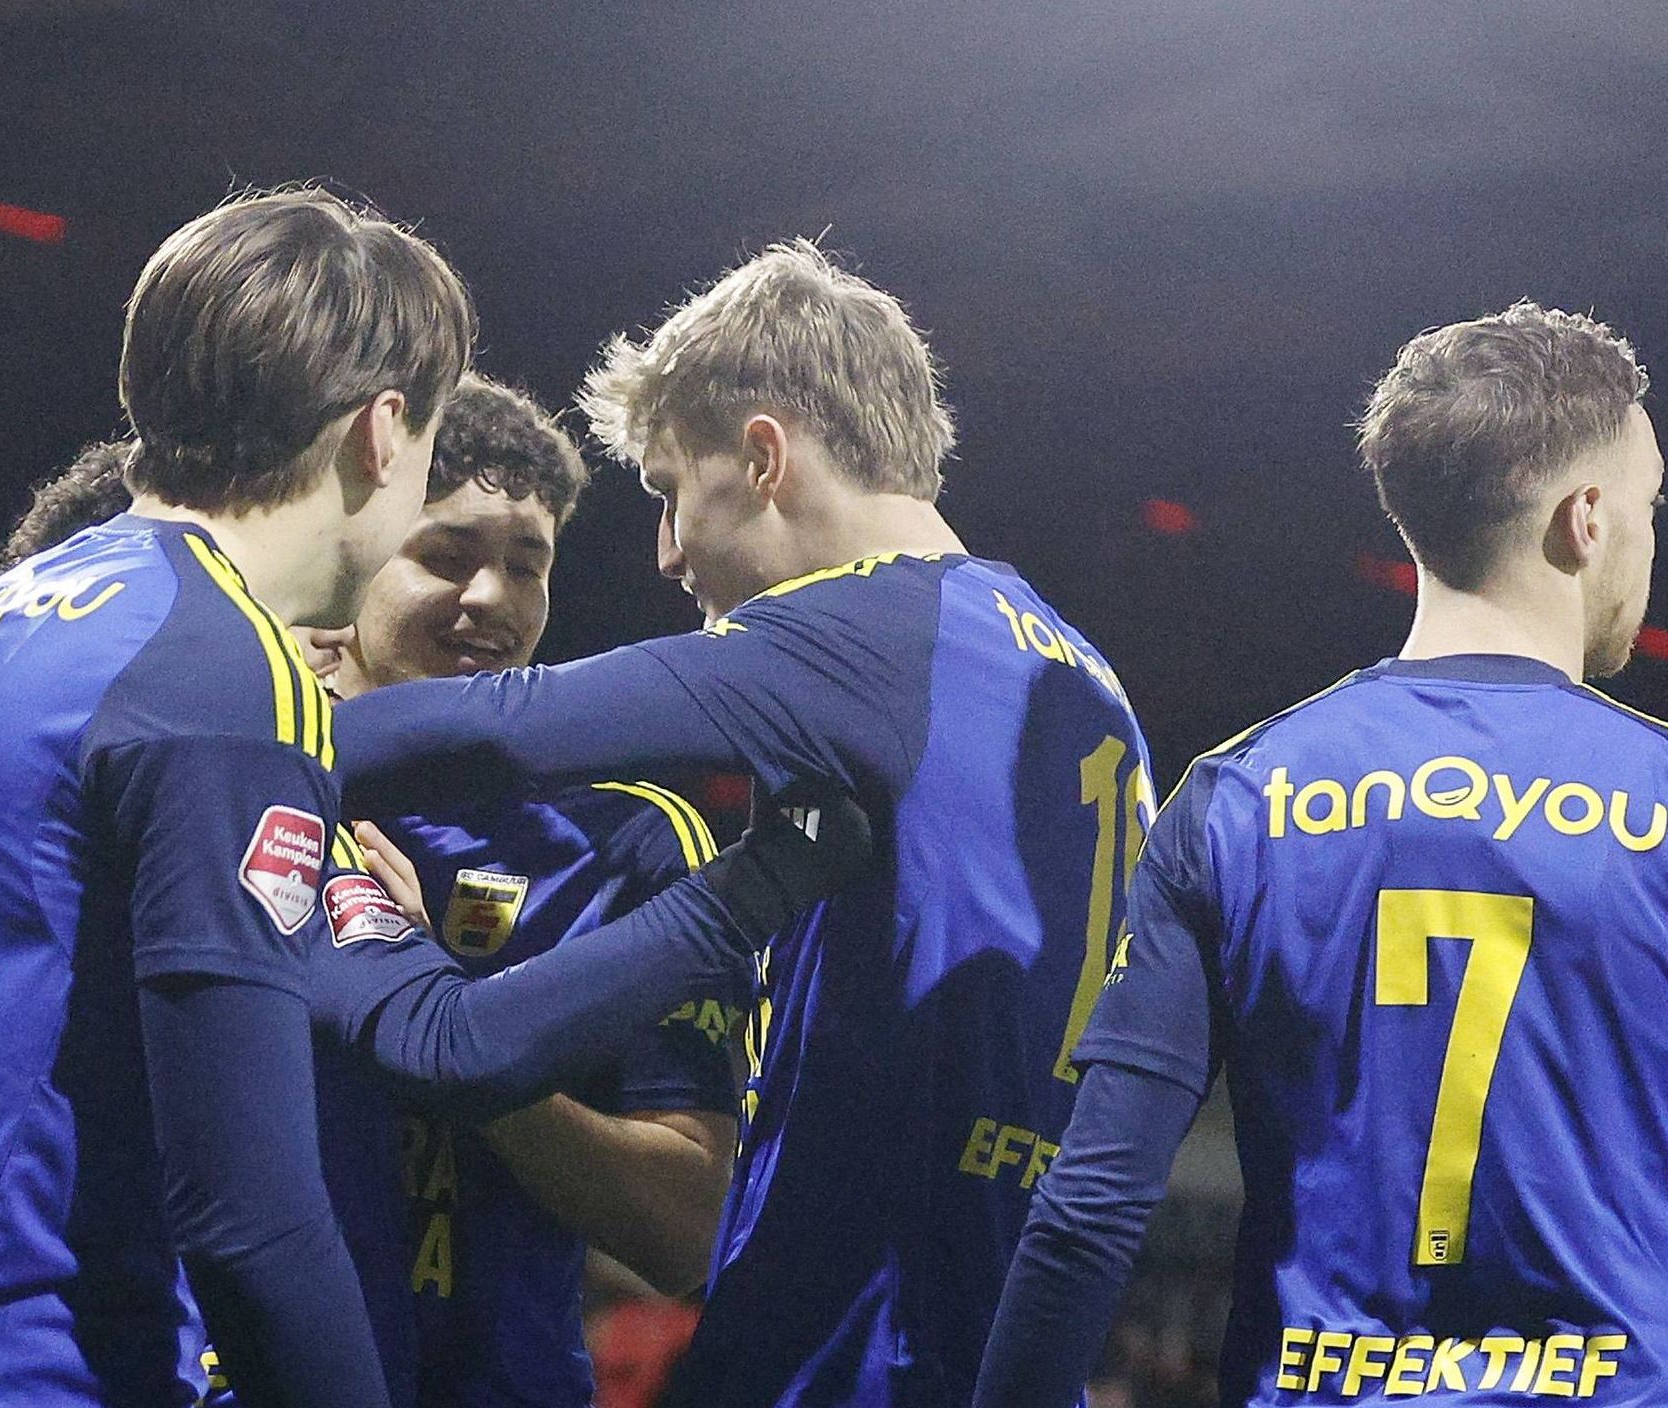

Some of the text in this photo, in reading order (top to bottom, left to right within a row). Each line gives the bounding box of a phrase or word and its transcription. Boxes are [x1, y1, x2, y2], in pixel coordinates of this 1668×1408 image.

[1263, 757, 1668, 852] tanQyou
[1375, 889, 1534, 1267] 7
[1277, 1328, 1629, 1398] EFFEKTIEF
